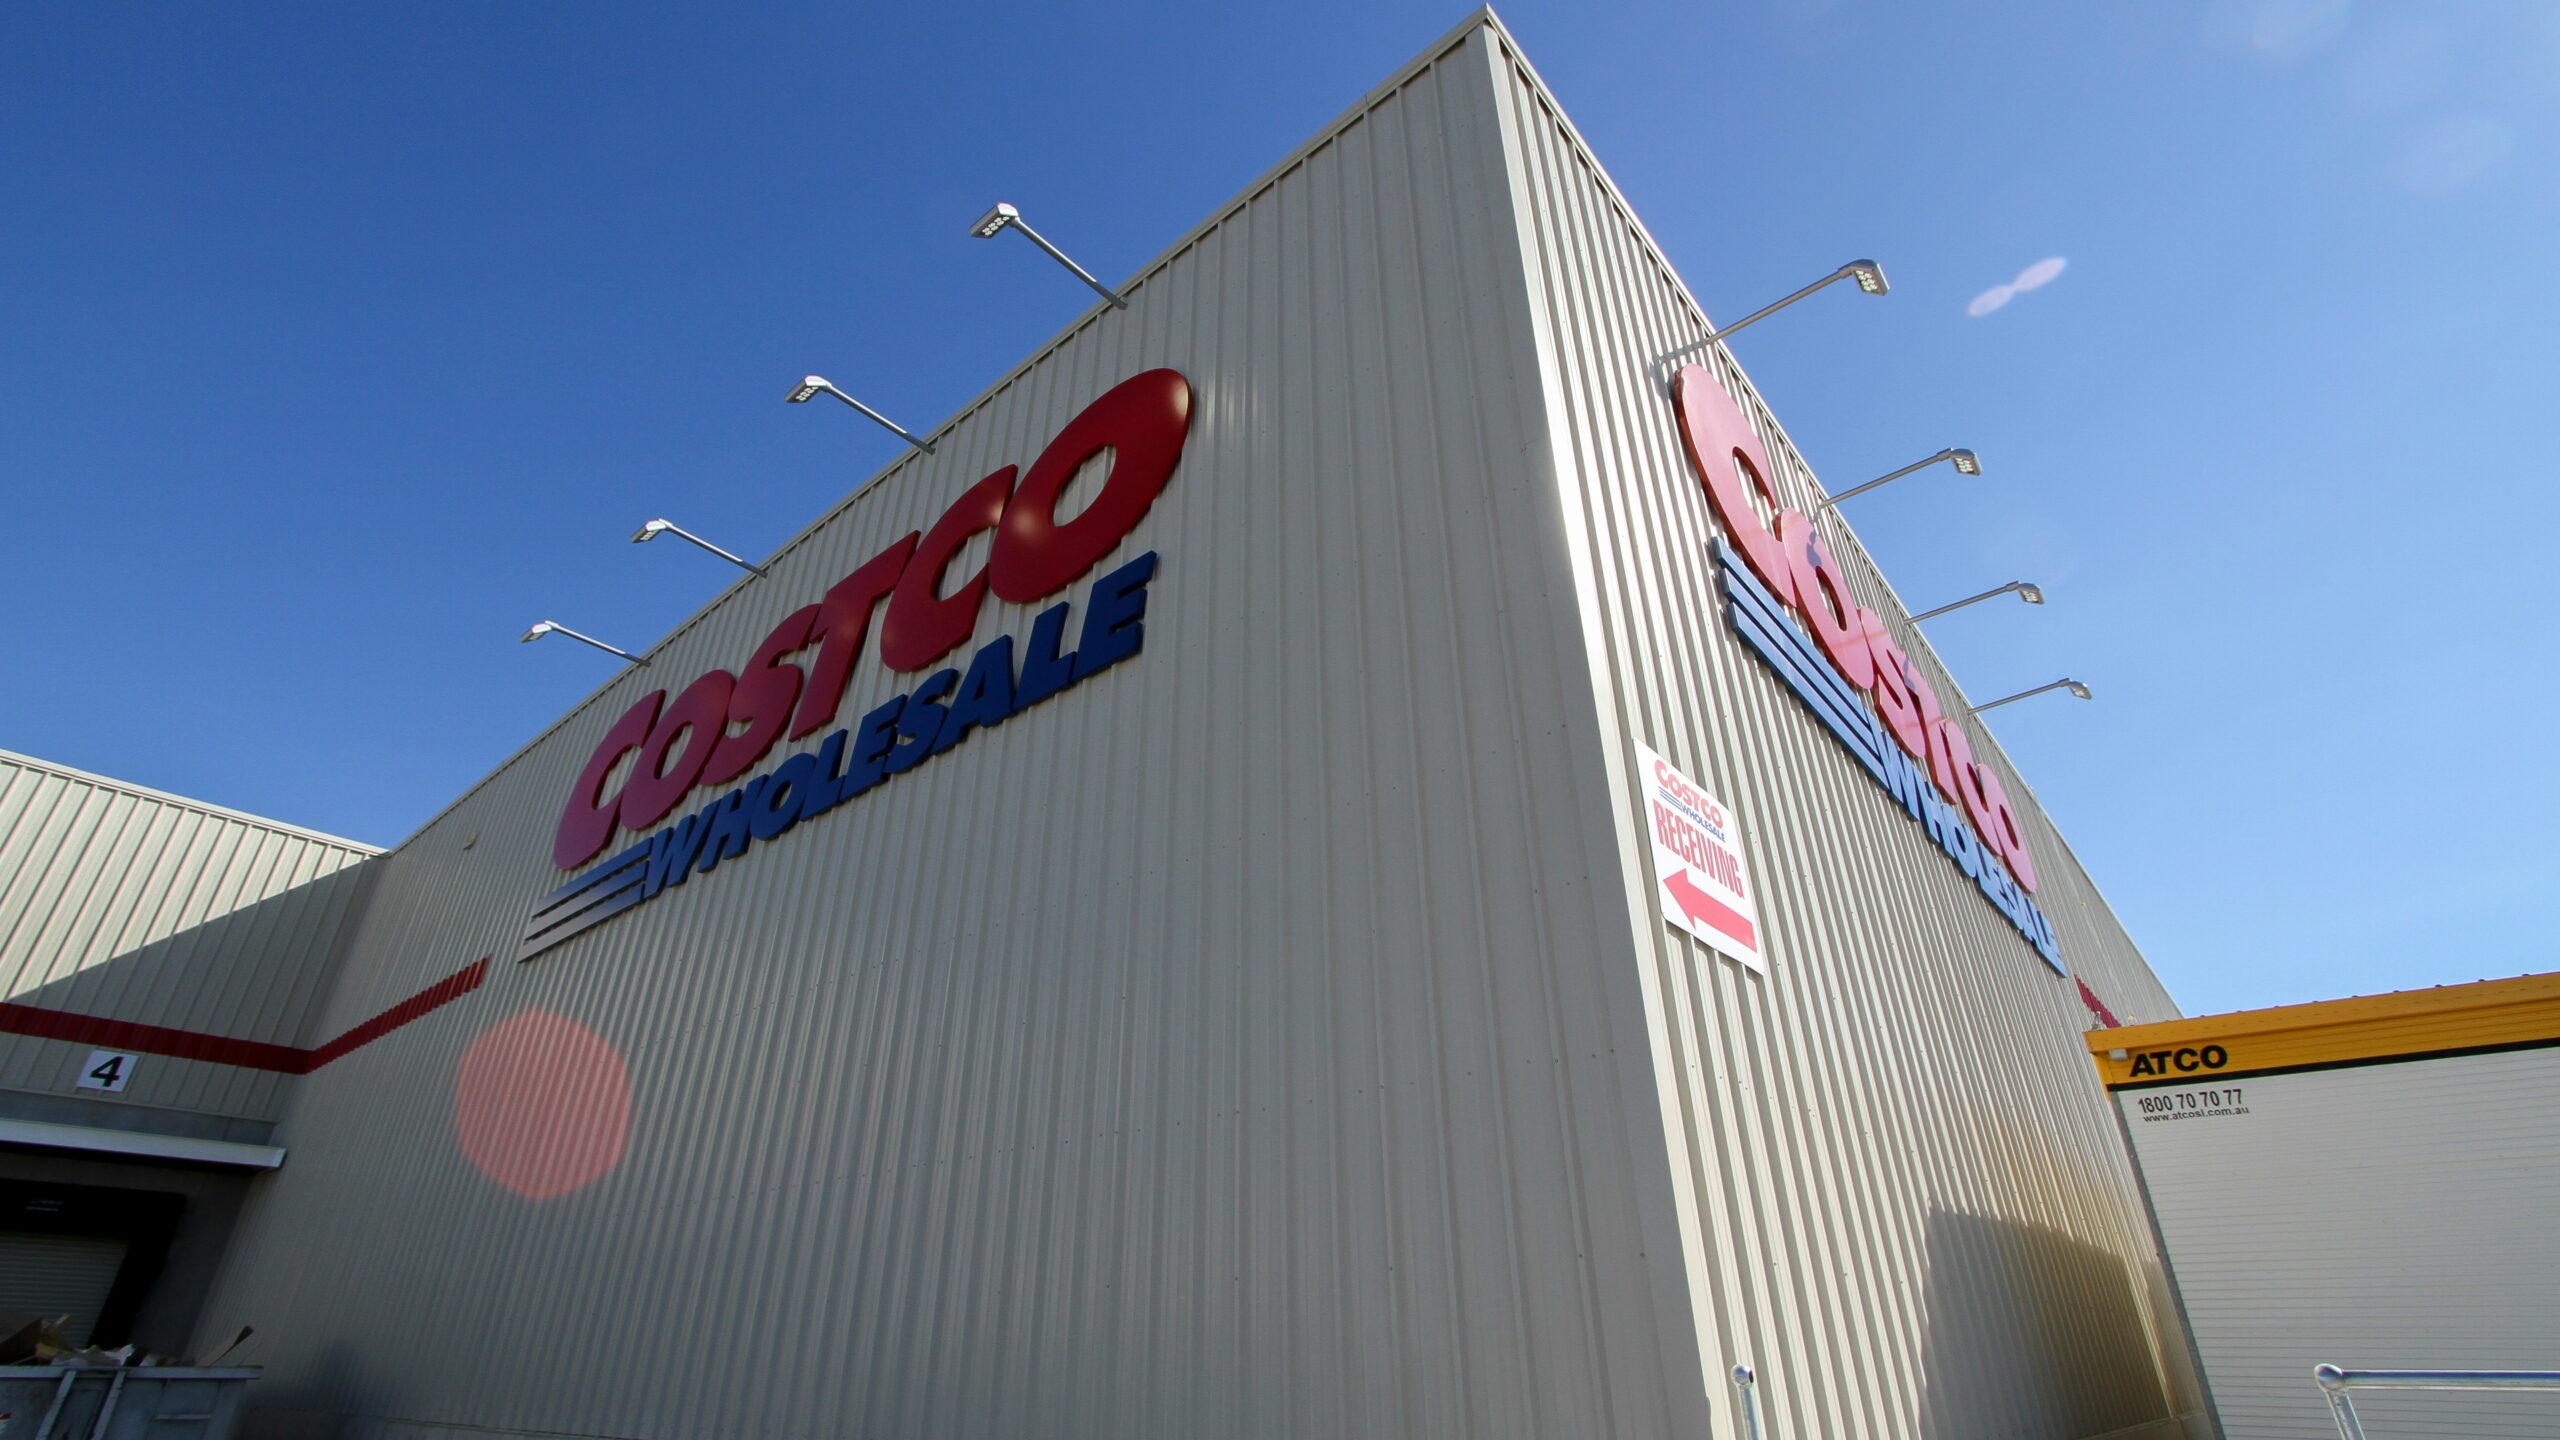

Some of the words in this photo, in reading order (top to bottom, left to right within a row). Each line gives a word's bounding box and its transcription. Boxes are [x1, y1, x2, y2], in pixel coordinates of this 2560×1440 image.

[554, 368, 1193, 870] COSTCO
[1675, 364, 2037, 893] COSTCO
[643, 551, 1157, 900] WHOLESALE
[1654, 760, 1724, 829] COSTCO
[1680, 803, 1726, 843] WHOLESALE
[1653, 798, 1744, 899] RECEIVING
[1863, 706, 2068, 978] WHOLESALE
[90, 1056, 124, 1087] 4
[2129, 1045, 2228, 1077] ATCO
[2138, 1095, 2173, 1113] 1800
[2175, 1093, 2196, 1109] 70
[2199, 1091, 2220, 1107] 70
[2223, 1089, 2242, 1105] 77
